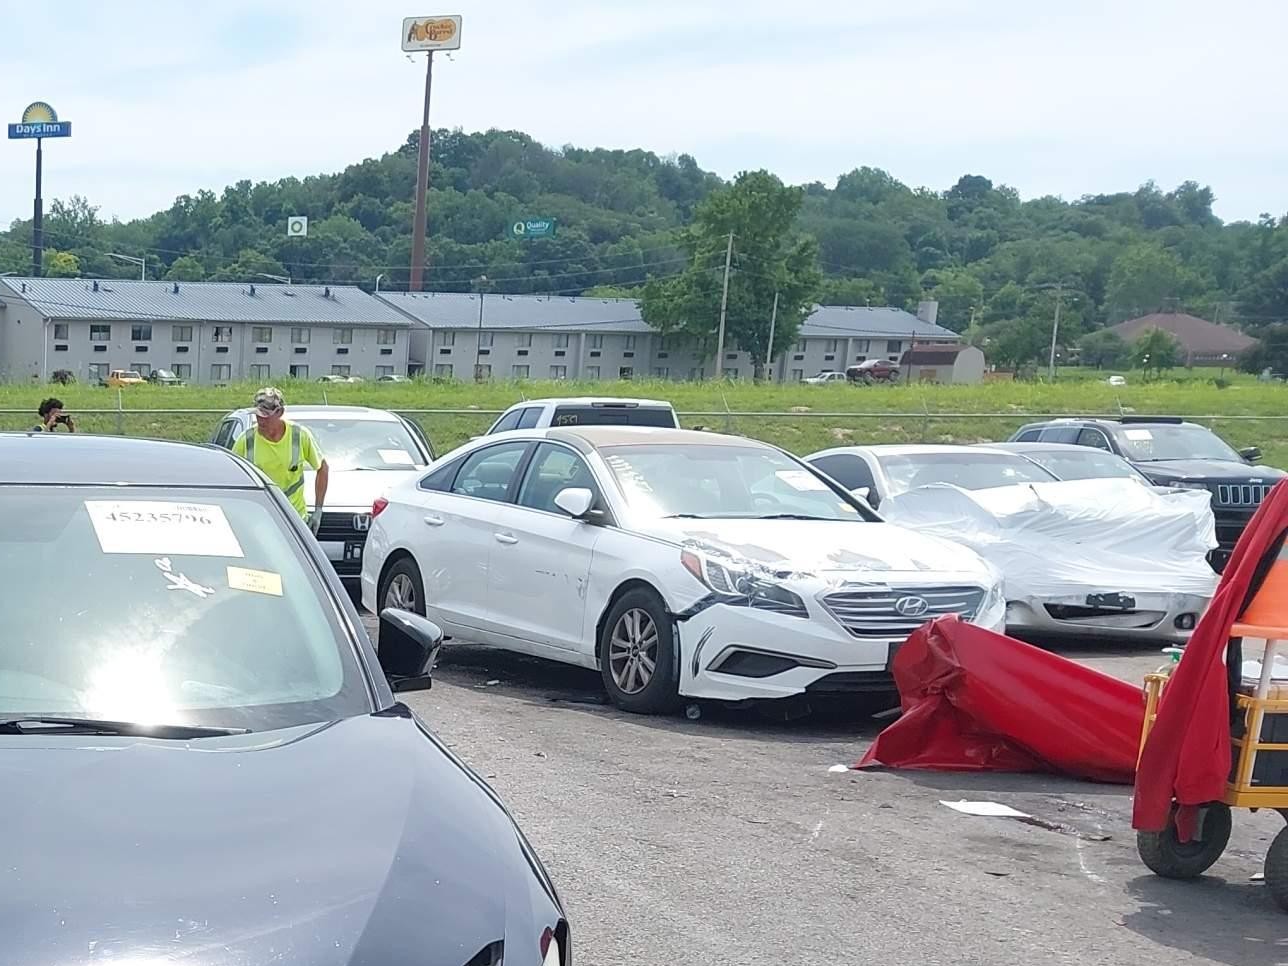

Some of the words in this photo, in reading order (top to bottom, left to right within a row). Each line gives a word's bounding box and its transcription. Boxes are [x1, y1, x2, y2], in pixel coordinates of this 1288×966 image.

[16, 124, 42, 135] Days
[43, 123, 60, 133] Inn
[526, 221, 550, 229] Quality
[105, 511, 213, 526] 45235796
